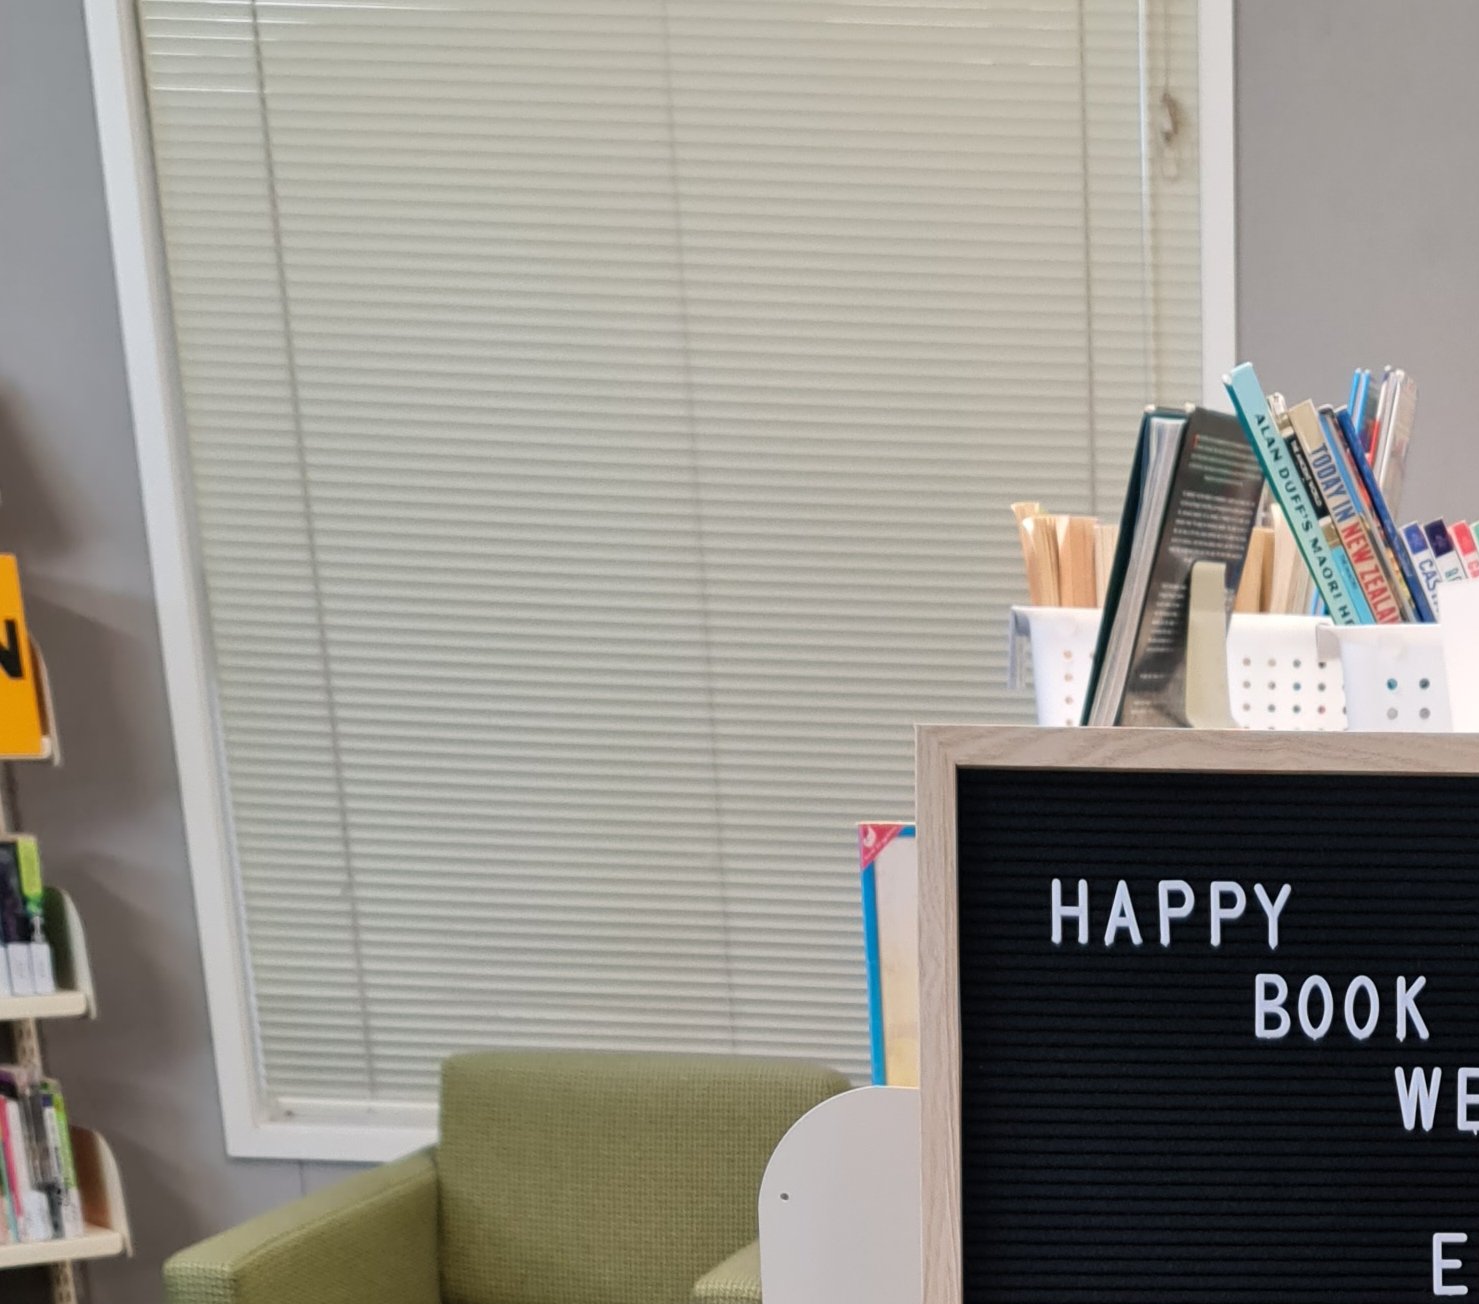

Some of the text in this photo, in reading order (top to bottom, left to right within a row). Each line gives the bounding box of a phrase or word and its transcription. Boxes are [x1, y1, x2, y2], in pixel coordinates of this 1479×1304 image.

[1254, 413, 1283, 463] ALAN
[1278, 466, 1313, 535] DUFF'S
[1310, 441, 1347, 500] TODAY
[1331, 498, 1357, 523] IN
[1340, 520, 1374, 565] NEW
[1050, 878, 1292, 949] HAPPY
[1254, 973, 1430, 1042] BOOK
